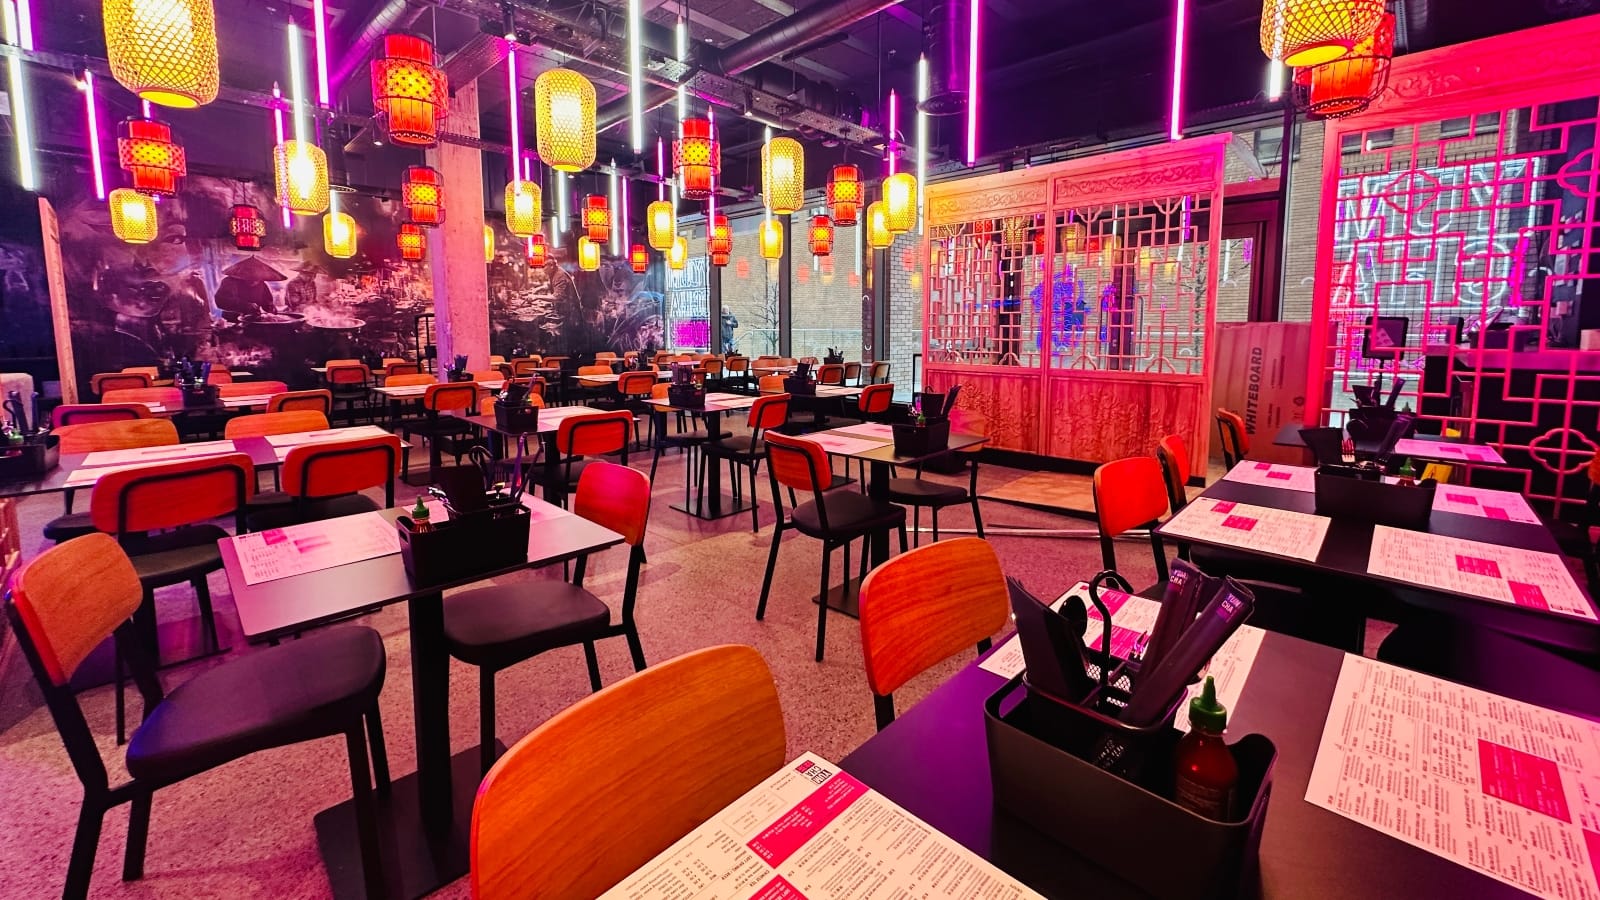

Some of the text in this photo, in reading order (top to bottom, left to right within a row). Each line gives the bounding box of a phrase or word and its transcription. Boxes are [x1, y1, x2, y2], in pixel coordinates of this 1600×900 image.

[1245, 347, 1262, 435] WHITEBOARD
[1221, 600, 1234, 613] CHA
[805, 765, 822, 777] CHA
[812, 769, 832, 784] YUM
